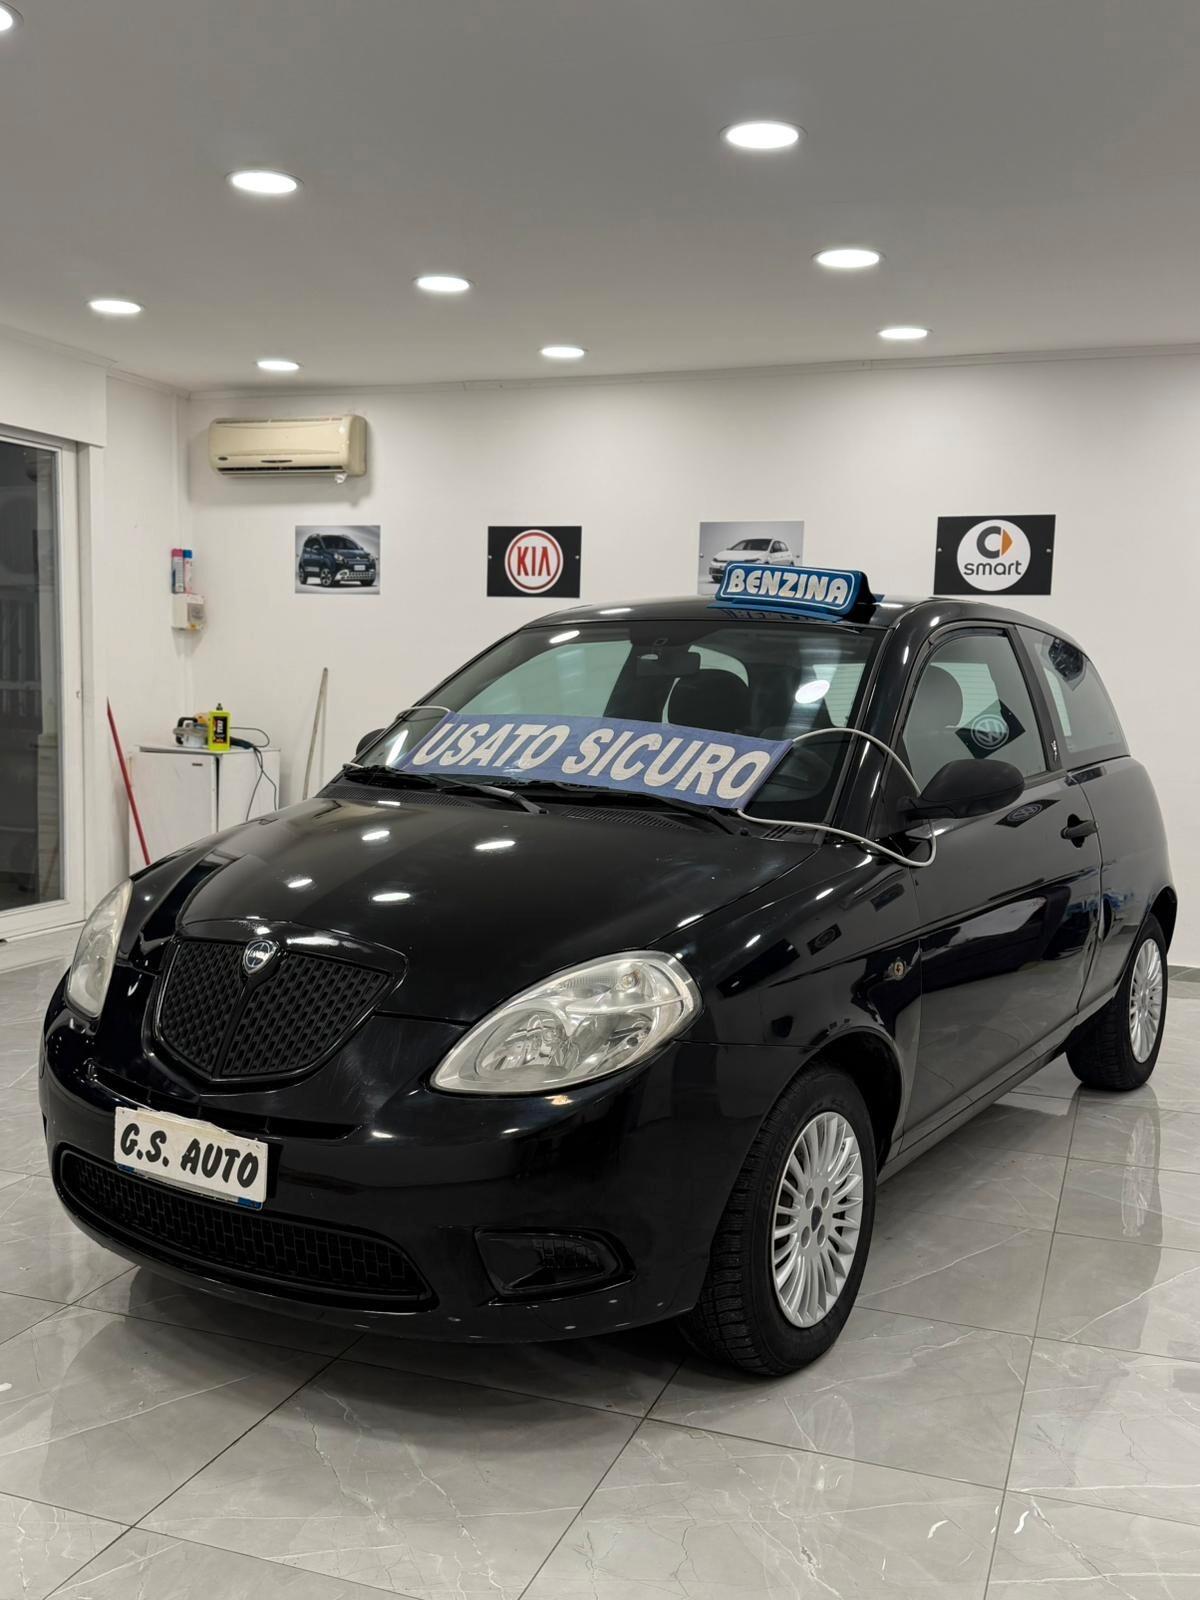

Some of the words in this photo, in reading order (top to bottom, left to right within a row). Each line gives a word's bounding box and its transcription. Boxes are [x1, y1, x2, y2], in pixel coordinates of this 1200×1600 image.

[516, 545, 551, 577] KIA
[963, 560, 1022, 576] smart
[727, 568, 848, 605] BENZINA
[412, 723, 570, 770] USATO
[562, 727, 770, 800] SICURO
[120, 1123, 170, 1168] G.S.
[180, 1138, 259, 1188] AUTO
